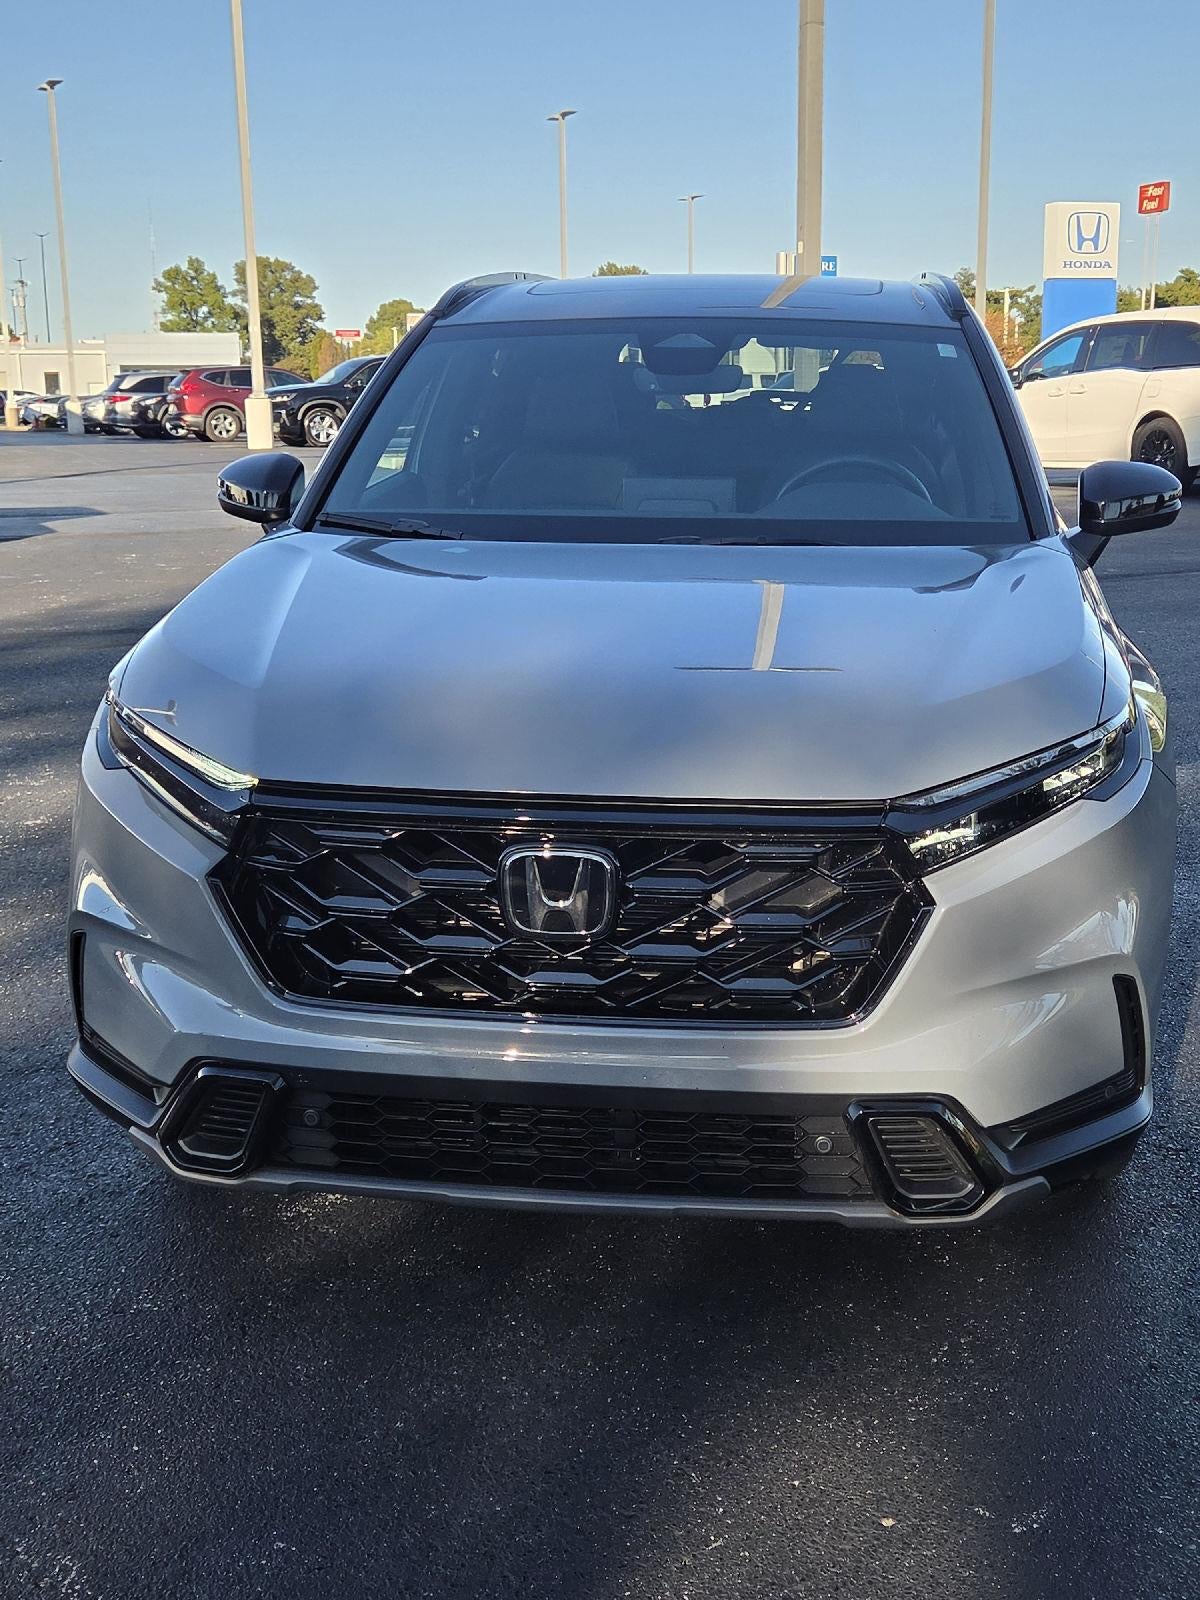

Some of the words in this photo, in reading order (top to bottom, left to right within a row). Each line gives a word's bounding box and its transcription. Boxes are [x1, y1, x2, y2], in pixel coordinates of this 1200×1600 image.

[1148, 185, 1164, 197] Fast
[1142, 198, 1159, 210] Fuel
[1062, 260, 1112, 269] HONDA
